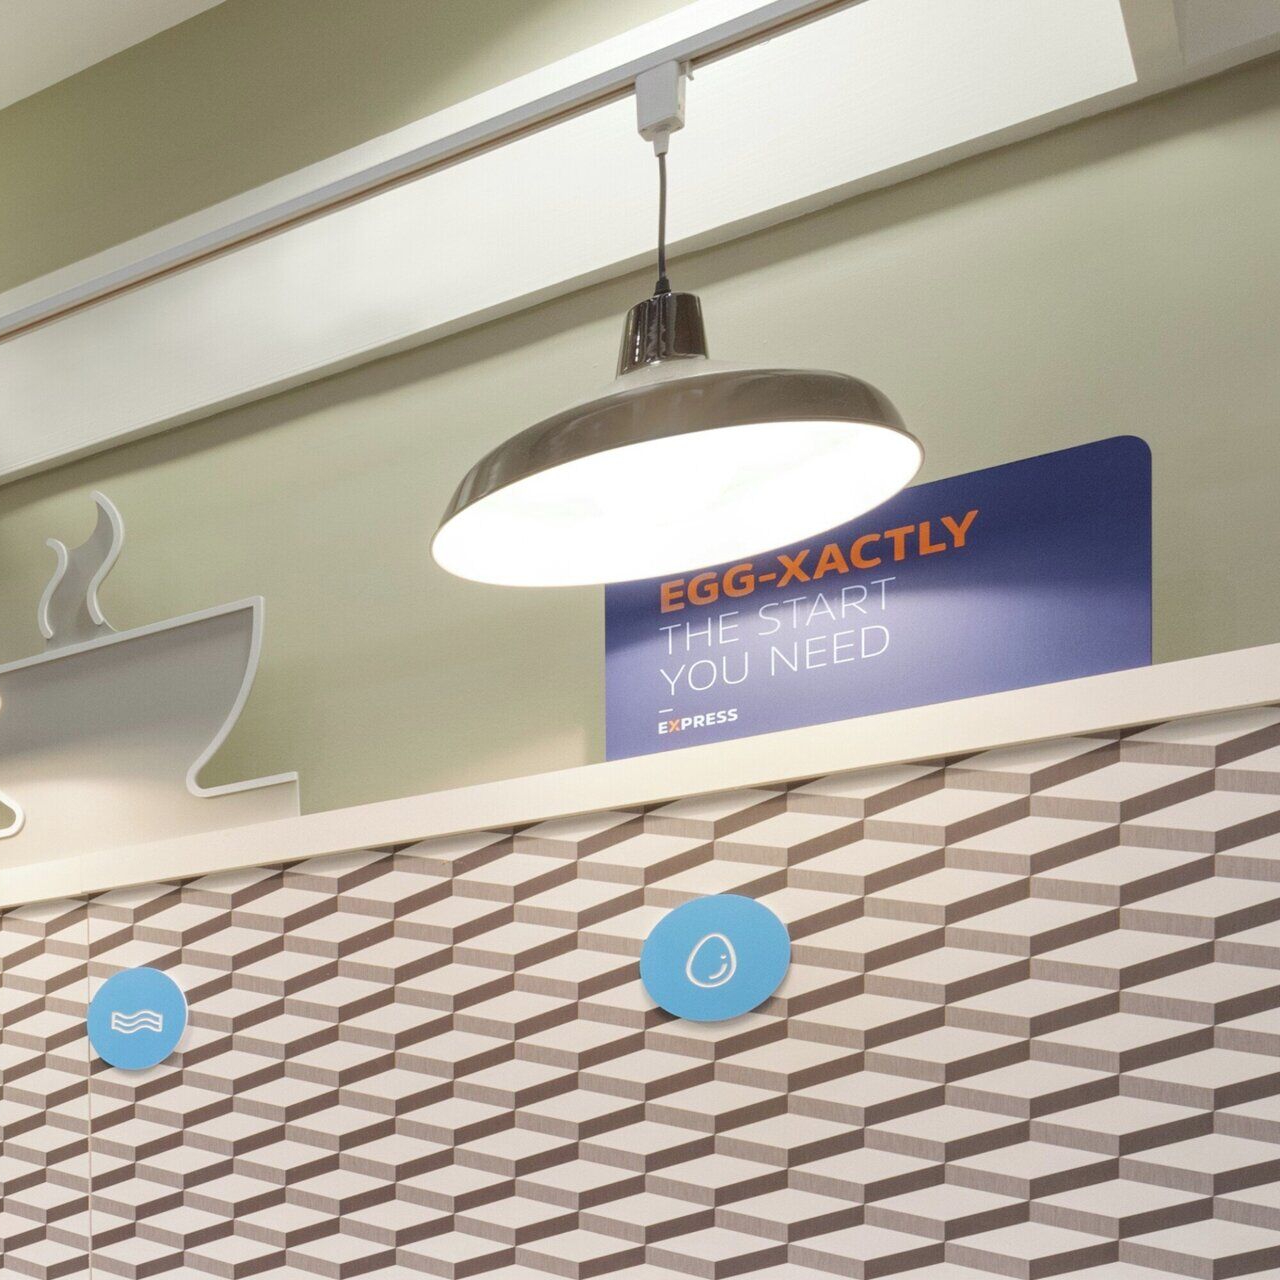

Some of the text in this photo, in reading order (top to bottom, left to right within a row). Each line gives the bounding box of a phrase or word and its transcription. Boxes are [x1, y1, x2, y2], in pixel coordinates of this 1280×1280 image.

[660, 510, 979, 613] EGG-XACTLY
[660, 577, 896, 655] THE START
[659, 625, 890, 696] YOU NEED
[658, 708, 739, 734] EXPRESS
